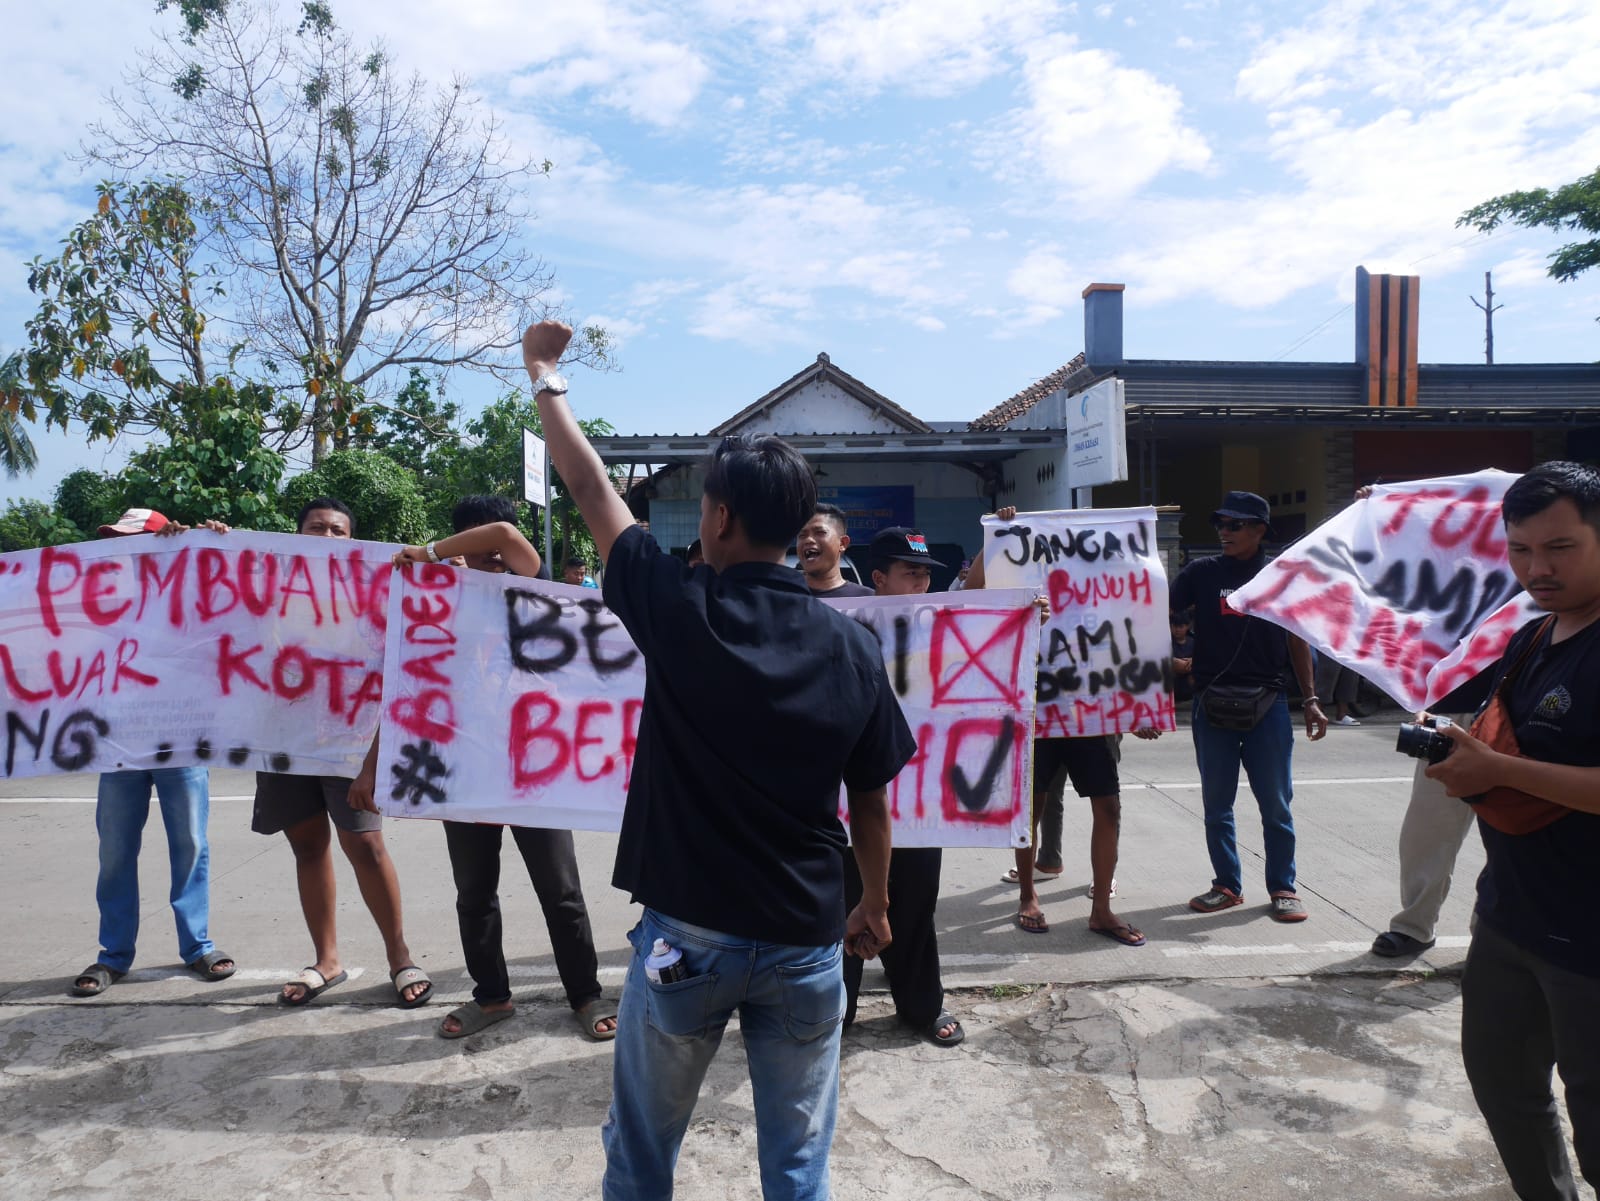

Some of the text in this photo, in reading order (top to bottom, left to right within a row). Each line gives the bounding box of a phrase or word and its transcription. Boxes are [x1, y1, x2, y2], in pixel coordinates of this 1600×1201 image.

[995, 519, 1148, 566] JANGAN
[1382, 487, 1510, 562] TOL
[1047, 568, 1152, 614] BUNUH
[1037, 617, 1138, 667] AMI
[0, 637, 159, 703] LUAR
[215, 634, 383, 726] KOTA
